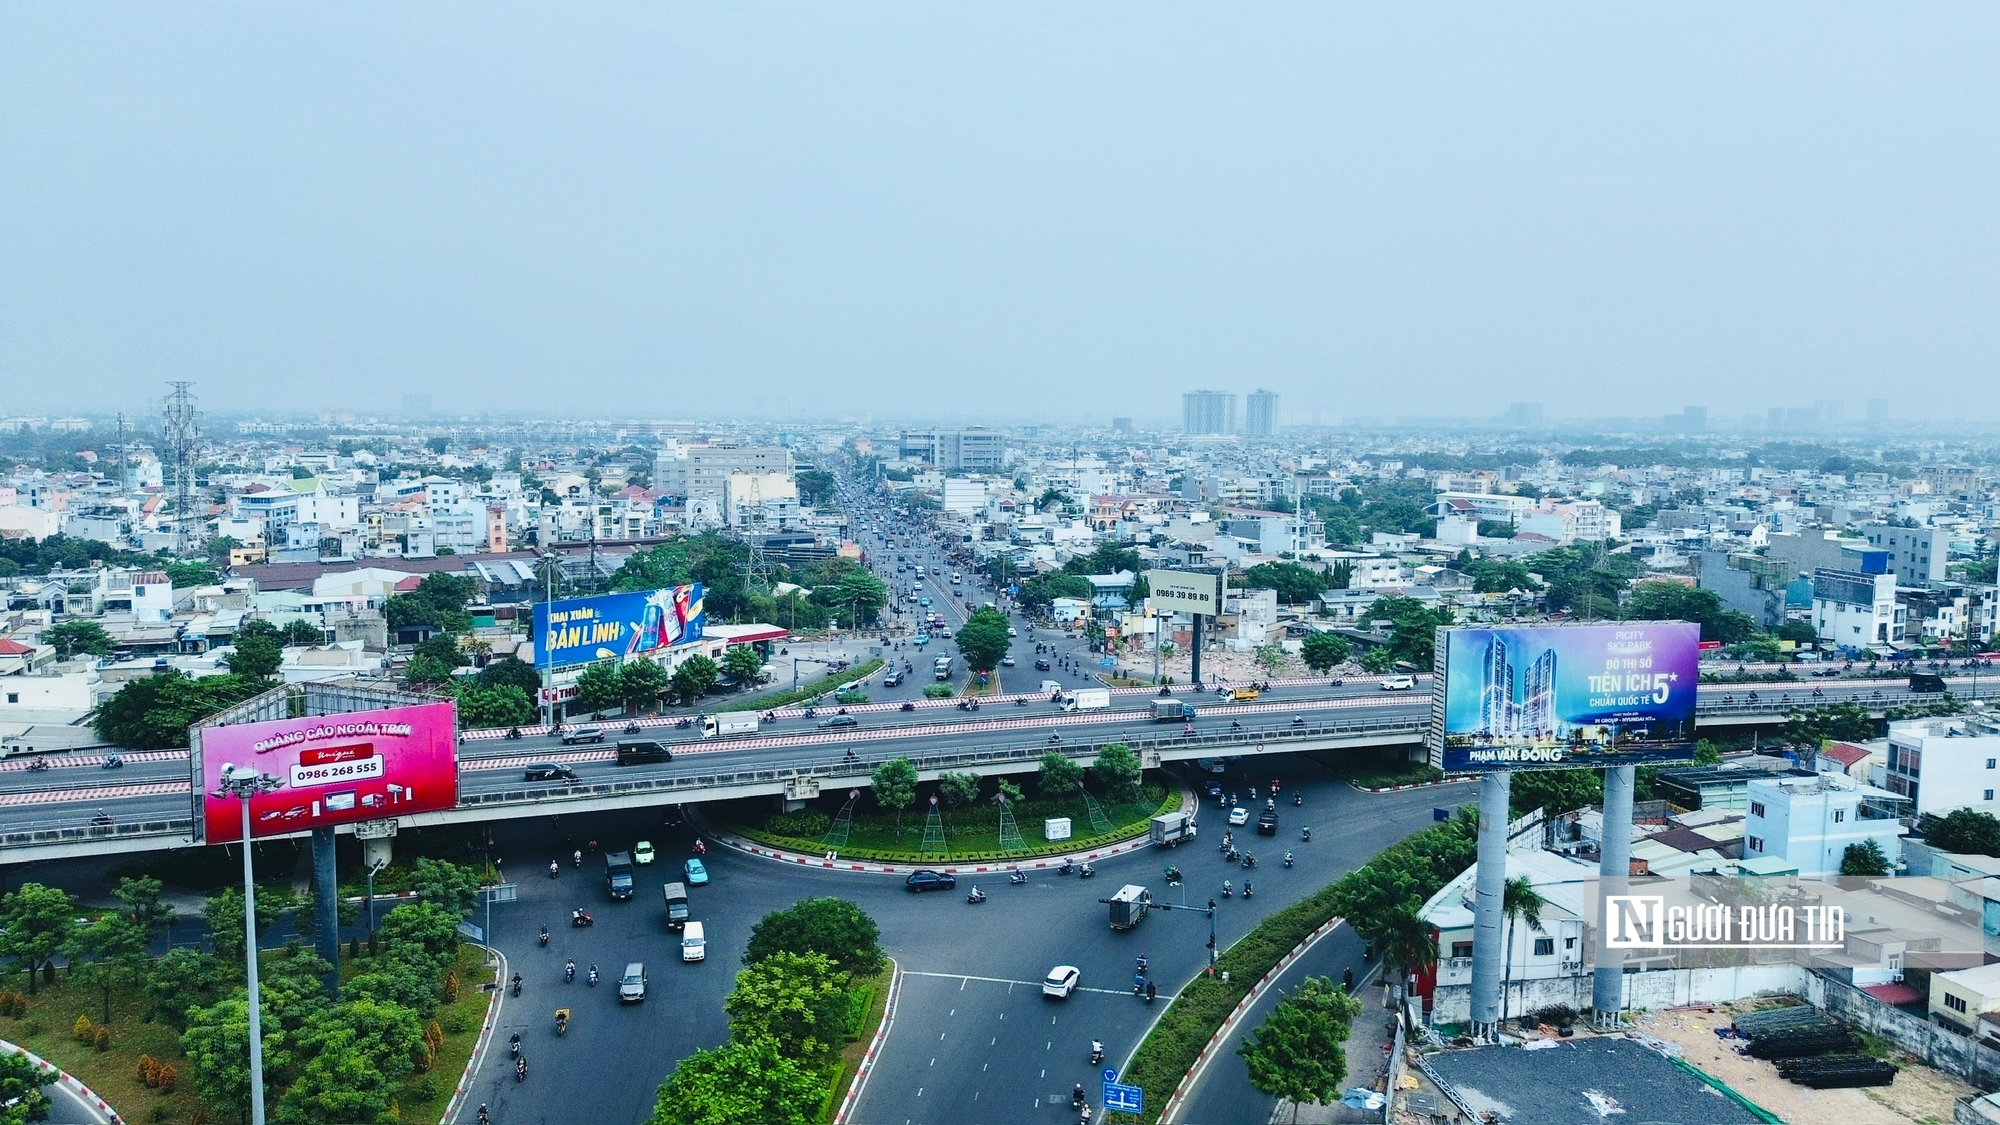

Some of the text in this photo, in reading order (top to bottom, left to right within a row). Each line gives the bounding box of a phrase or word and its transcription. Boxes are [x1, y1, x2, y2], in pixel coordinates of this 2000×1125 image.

[1156, 589, 1175, 598] 0969
[570, 606, 594, 621] XUÂN
[545, 619, 620, 651] BẢN LĨNH
[1615, 630, 1645, 640] PICITY
[1606, 641, 1652, 651] SKY PARK
[1605, 654, 1653, 671] ĐÔ THỊ SỐ
[1587, 670, 1669, 704] TIỆN ÍCH 5
[1589, 693, 1651, 707] CHUẨN QUỐC TẾ
[254, 731, 305, 753] QUẢNG
[306, 725, 335, 740] CÁO
[337, 721, 379, 735] NGOÀI
[317, 749, 355, 761] Unique
[1469, 750, 1495, 764] PHẠM
[297, 763, 377, 780] 0986 268 555
